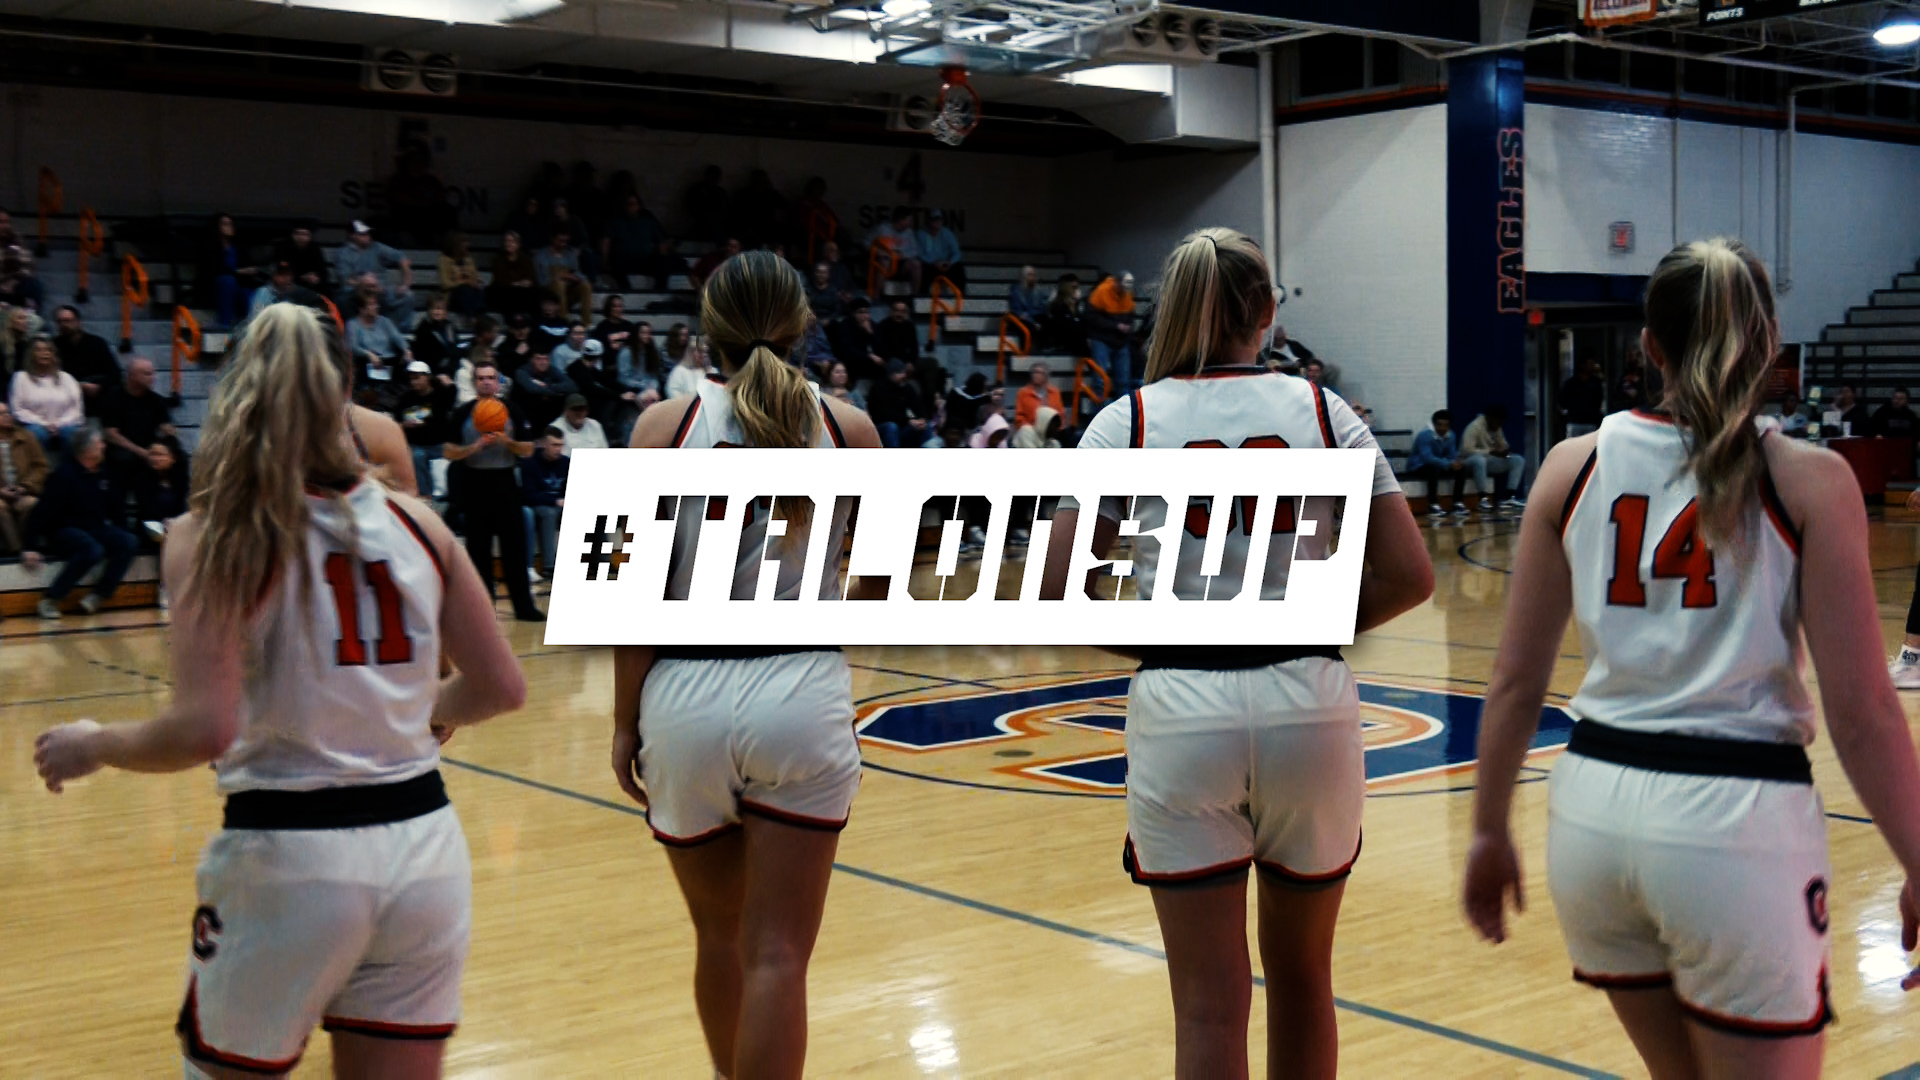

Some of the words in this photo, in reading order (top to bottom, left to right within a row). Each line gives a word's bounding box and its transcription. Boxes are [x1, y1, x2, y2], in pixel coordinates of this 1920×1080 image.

[340, 180, 489, 214] SEON
[897, 152, 926, 202] 4
[1497, 127, 1525, 314] EAGLES
[1606, 493, 1717, 607] 14
[325, 552, 415, 665] 11
[191, 905, 223, 962] C
